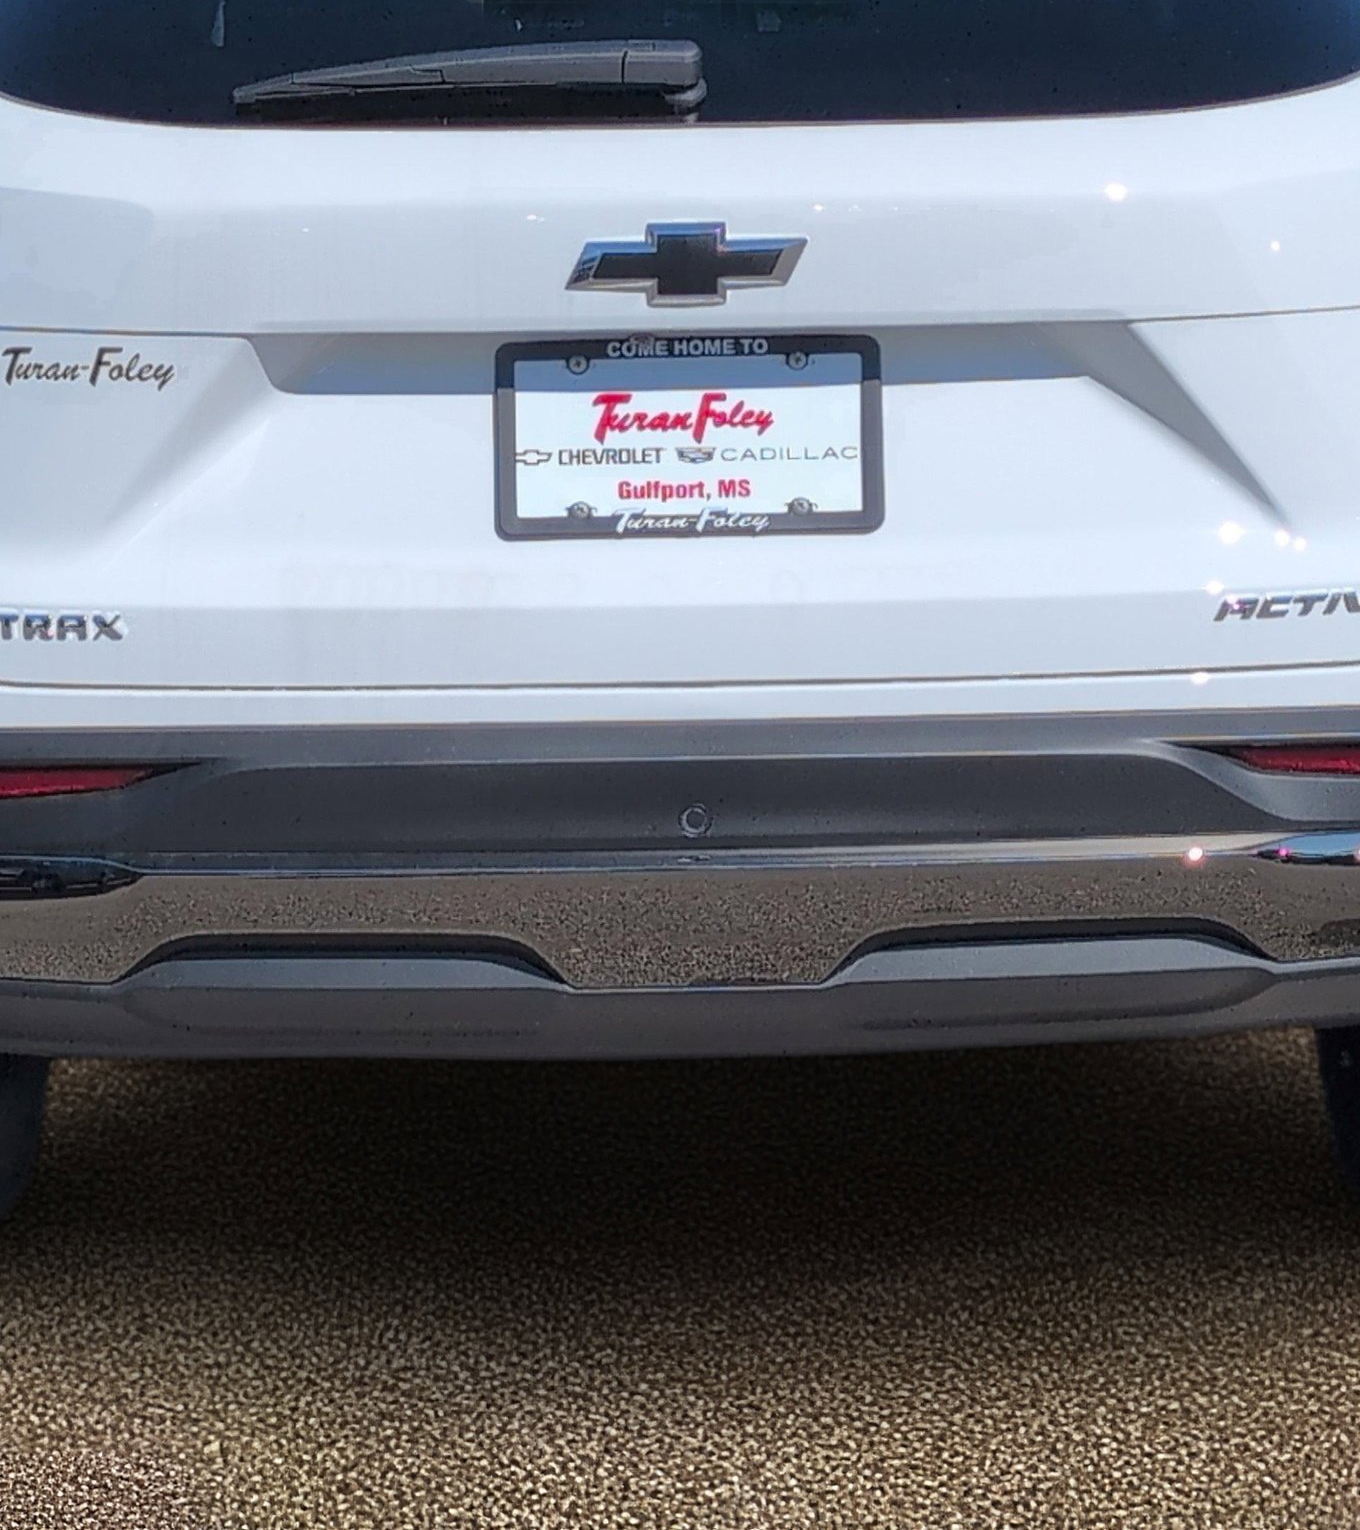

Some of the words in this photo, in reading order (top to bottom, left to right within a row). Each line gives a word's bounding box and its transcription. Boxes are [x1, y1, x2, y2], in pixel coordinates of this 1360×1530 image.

[606, 339, 669, 358] COME
[673, 337, 736, 356] HOME
[739, 337, 769, 355] TO
[558, 447, 664, 466] CHEVROLET
[720, 445, 859, 462] CADILLAC
[617, 479, 712, 502] Gulfport,
[717, 478, 752, 499] MS
